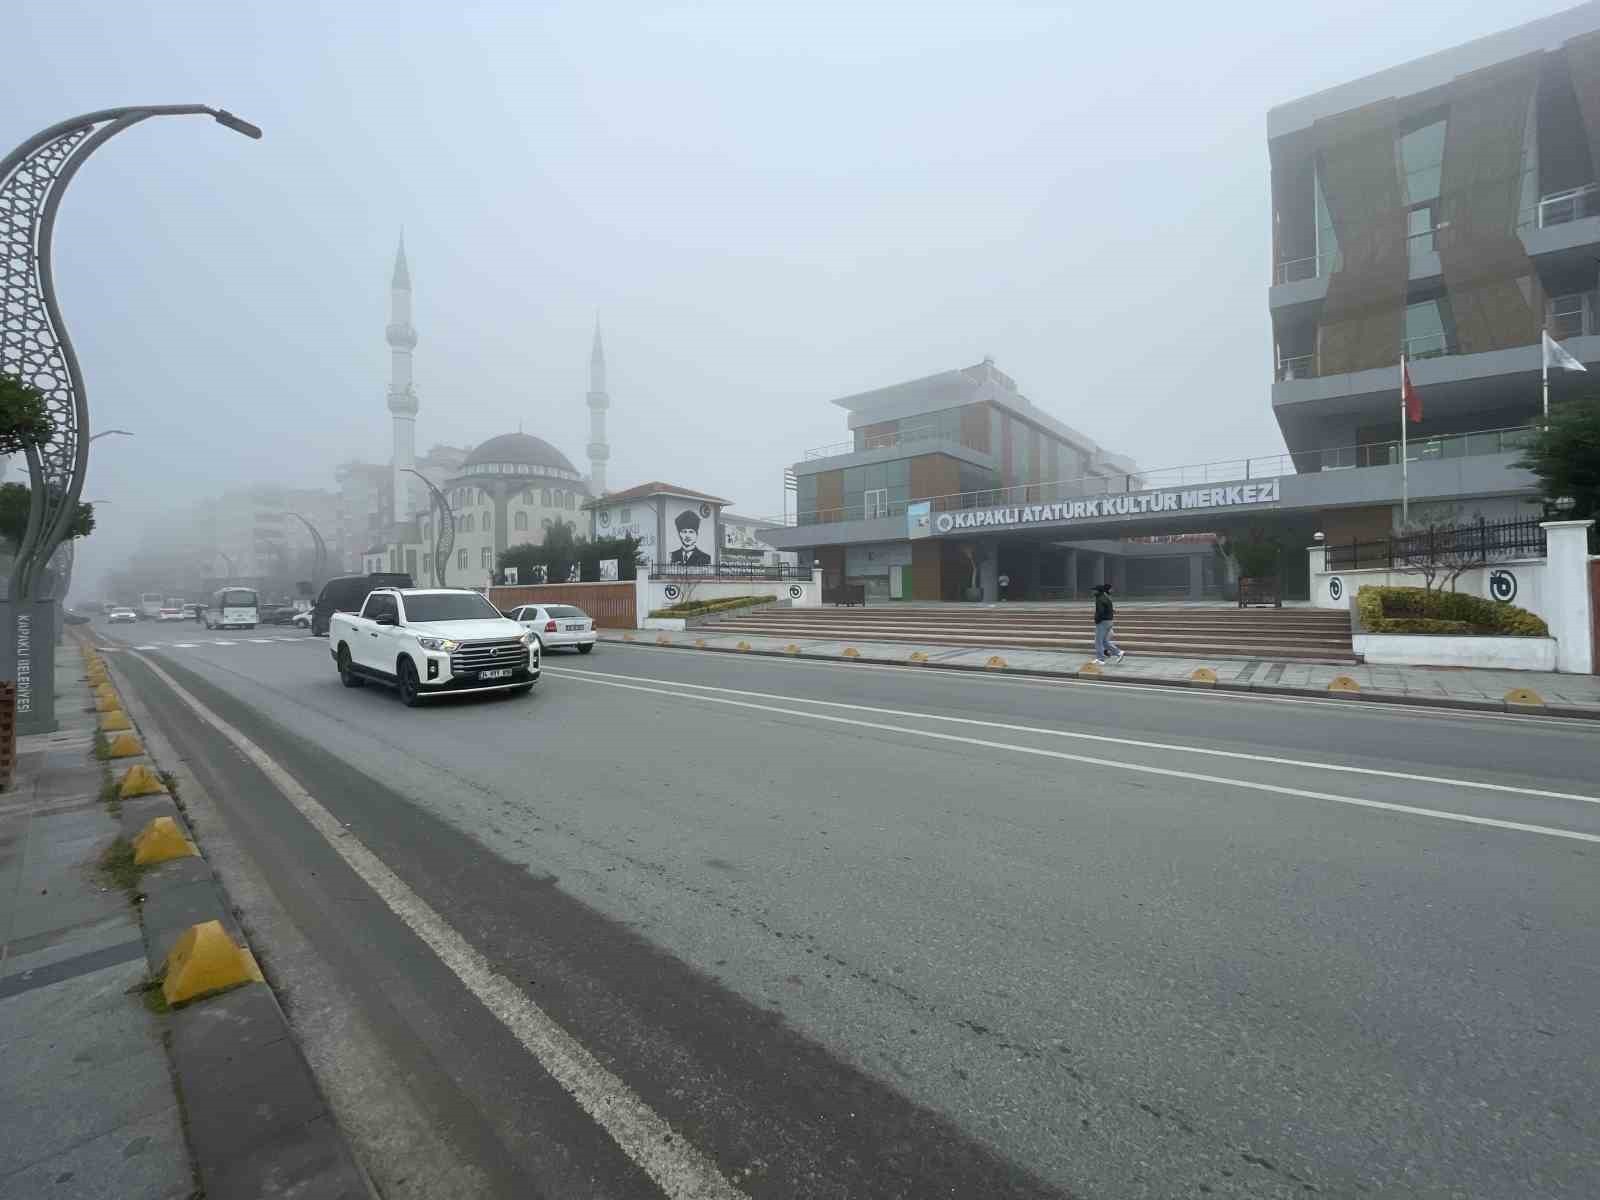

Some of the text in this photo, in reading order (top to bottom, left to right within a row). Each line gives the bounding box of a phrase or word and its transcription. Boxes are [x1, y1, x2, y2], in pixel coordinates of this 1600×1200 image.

[955, 478, 1281, 528] KAPAKLI ATATÜRK KÜLTÜR MERKEZİ
[17, 615, 31, 656] KAPAKLI
